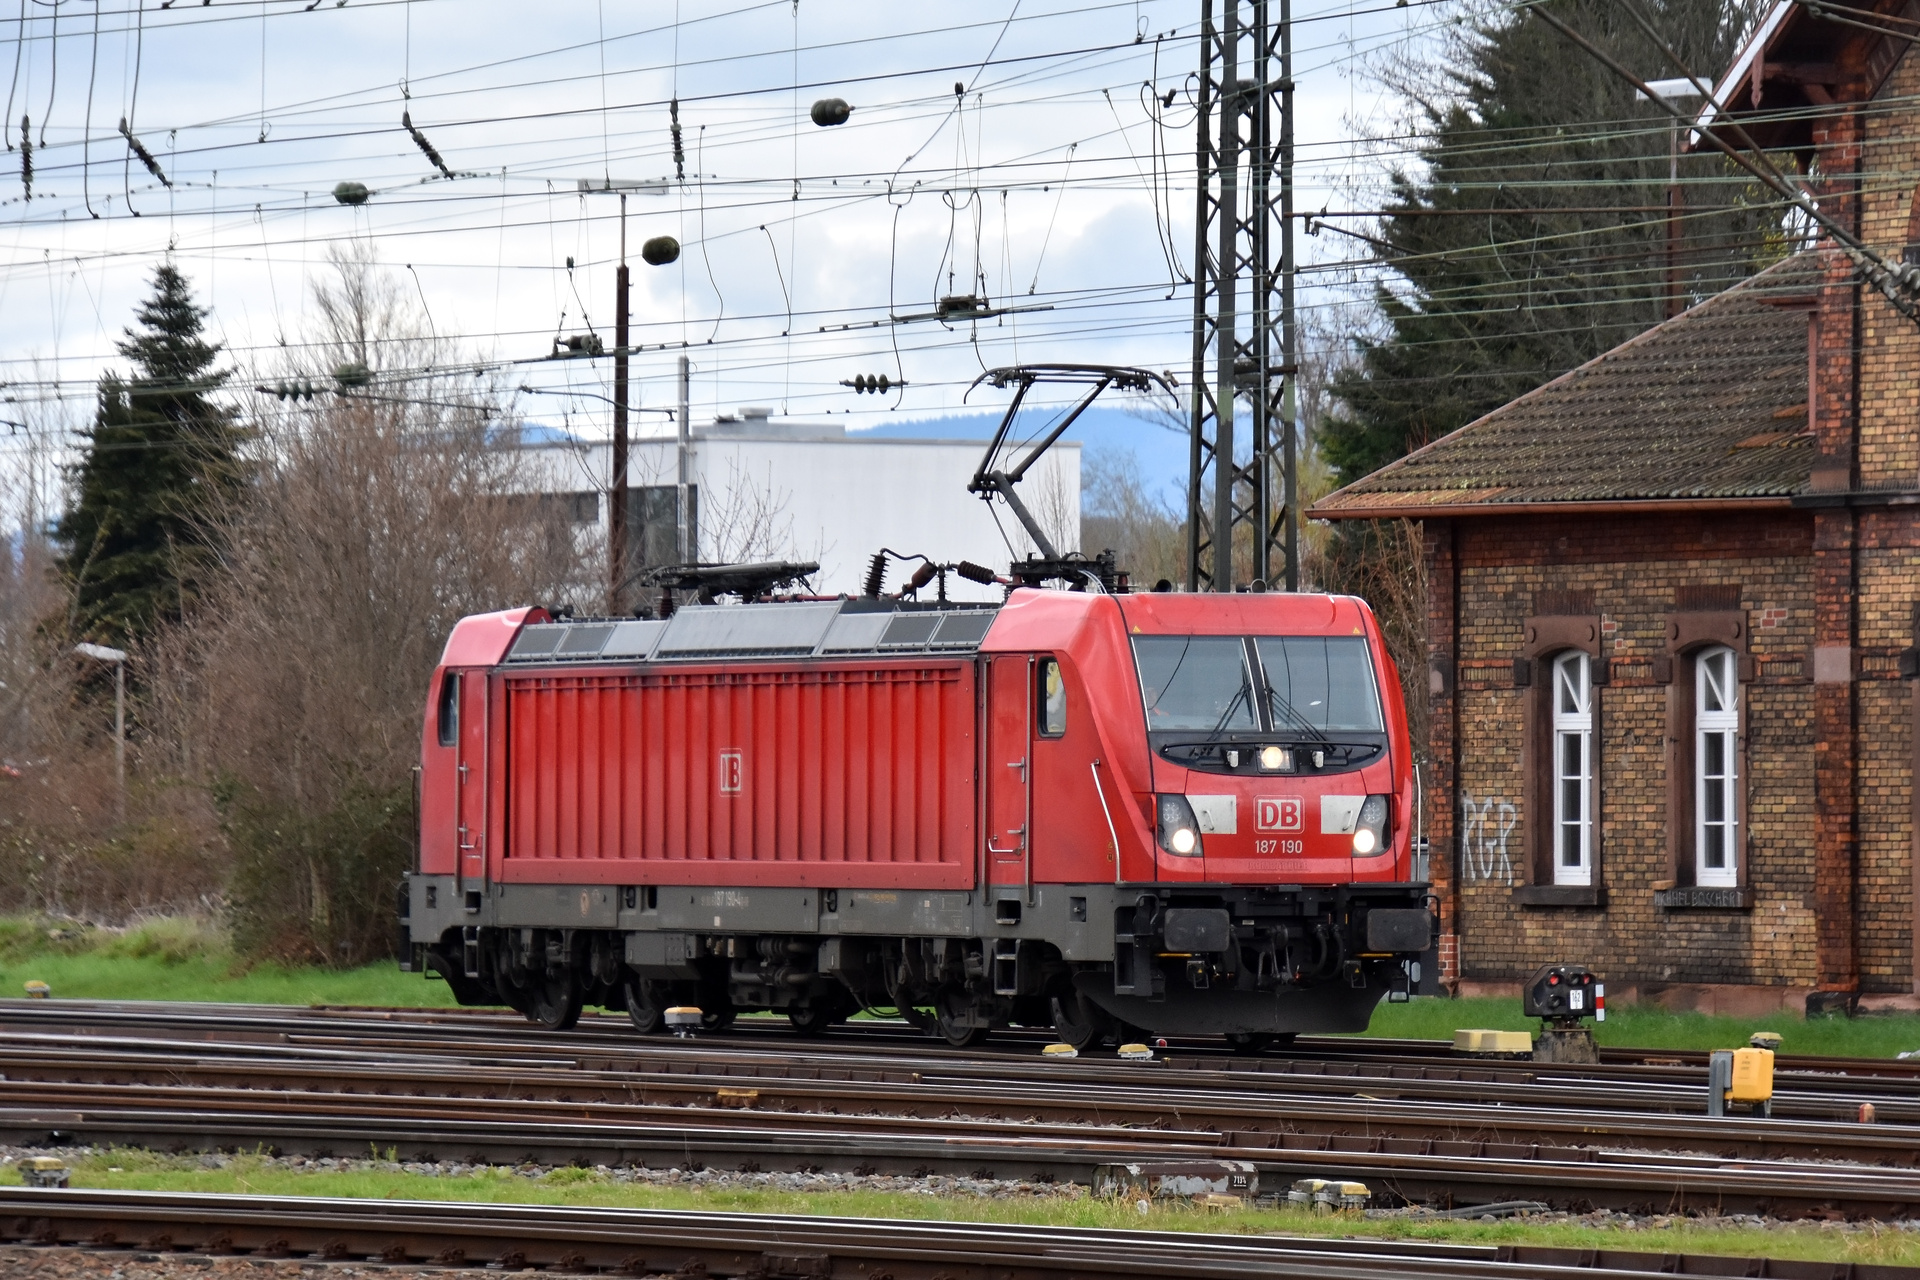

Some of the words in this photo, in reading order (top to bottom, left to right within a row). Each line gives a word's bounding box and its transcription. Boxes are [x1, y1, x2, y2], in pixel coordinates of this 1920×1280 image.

[1260, 801, 1299, 828] DB
[1255, 840, 1277, 854] 187
[1281, 840, 1303, 854] 190
